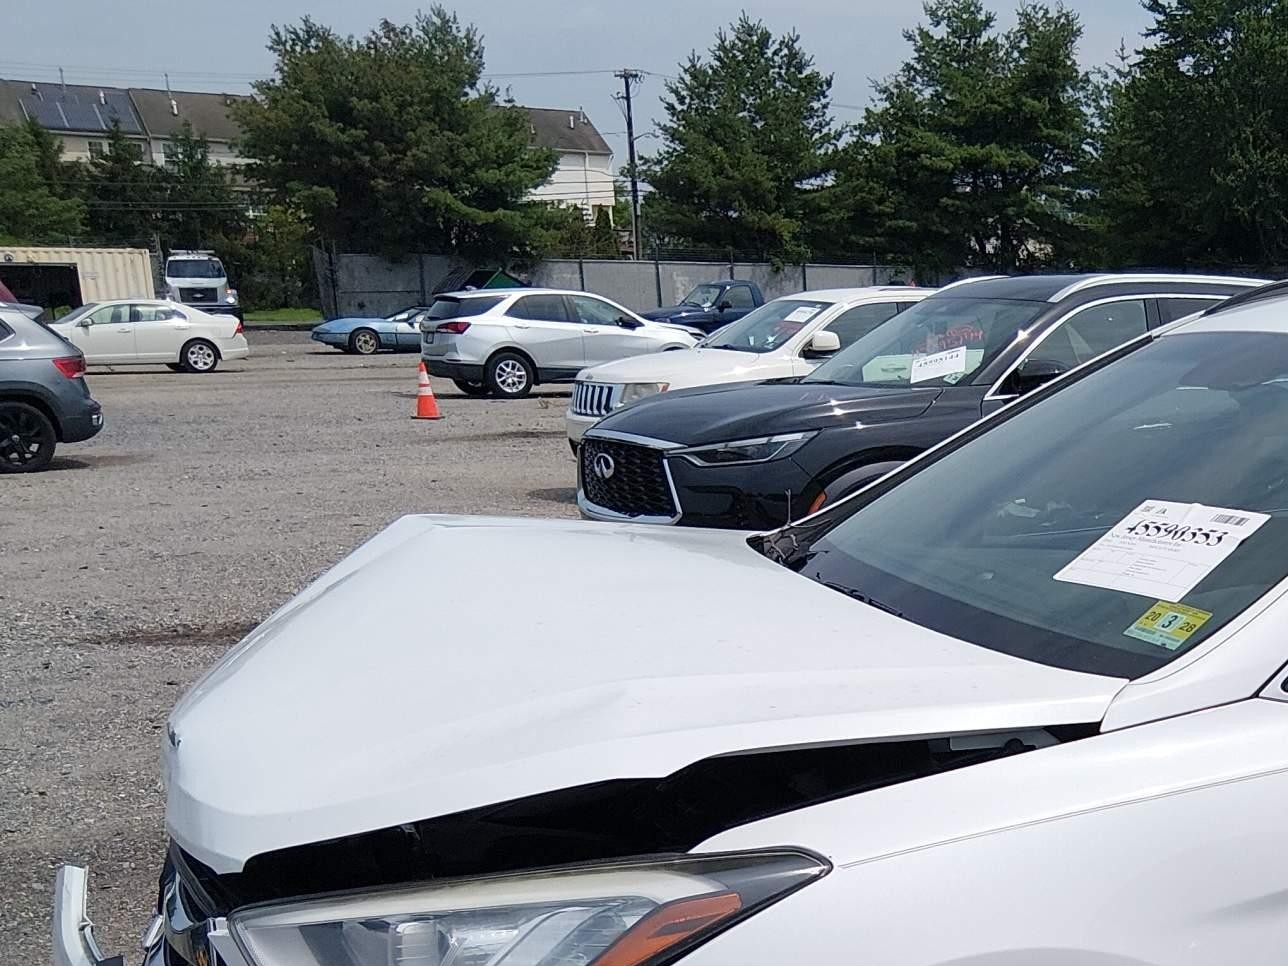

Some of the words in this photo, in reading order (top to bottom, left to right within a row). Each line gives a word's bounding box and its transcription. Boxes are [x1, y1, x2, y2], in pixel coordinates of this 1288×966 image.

[1125, 519, 1230, 546] 45590353
[1144, 611, 1162, 622] 20
[1161, 614, 1179, 629] 3
[1178, 621, 1197, 633] 28
